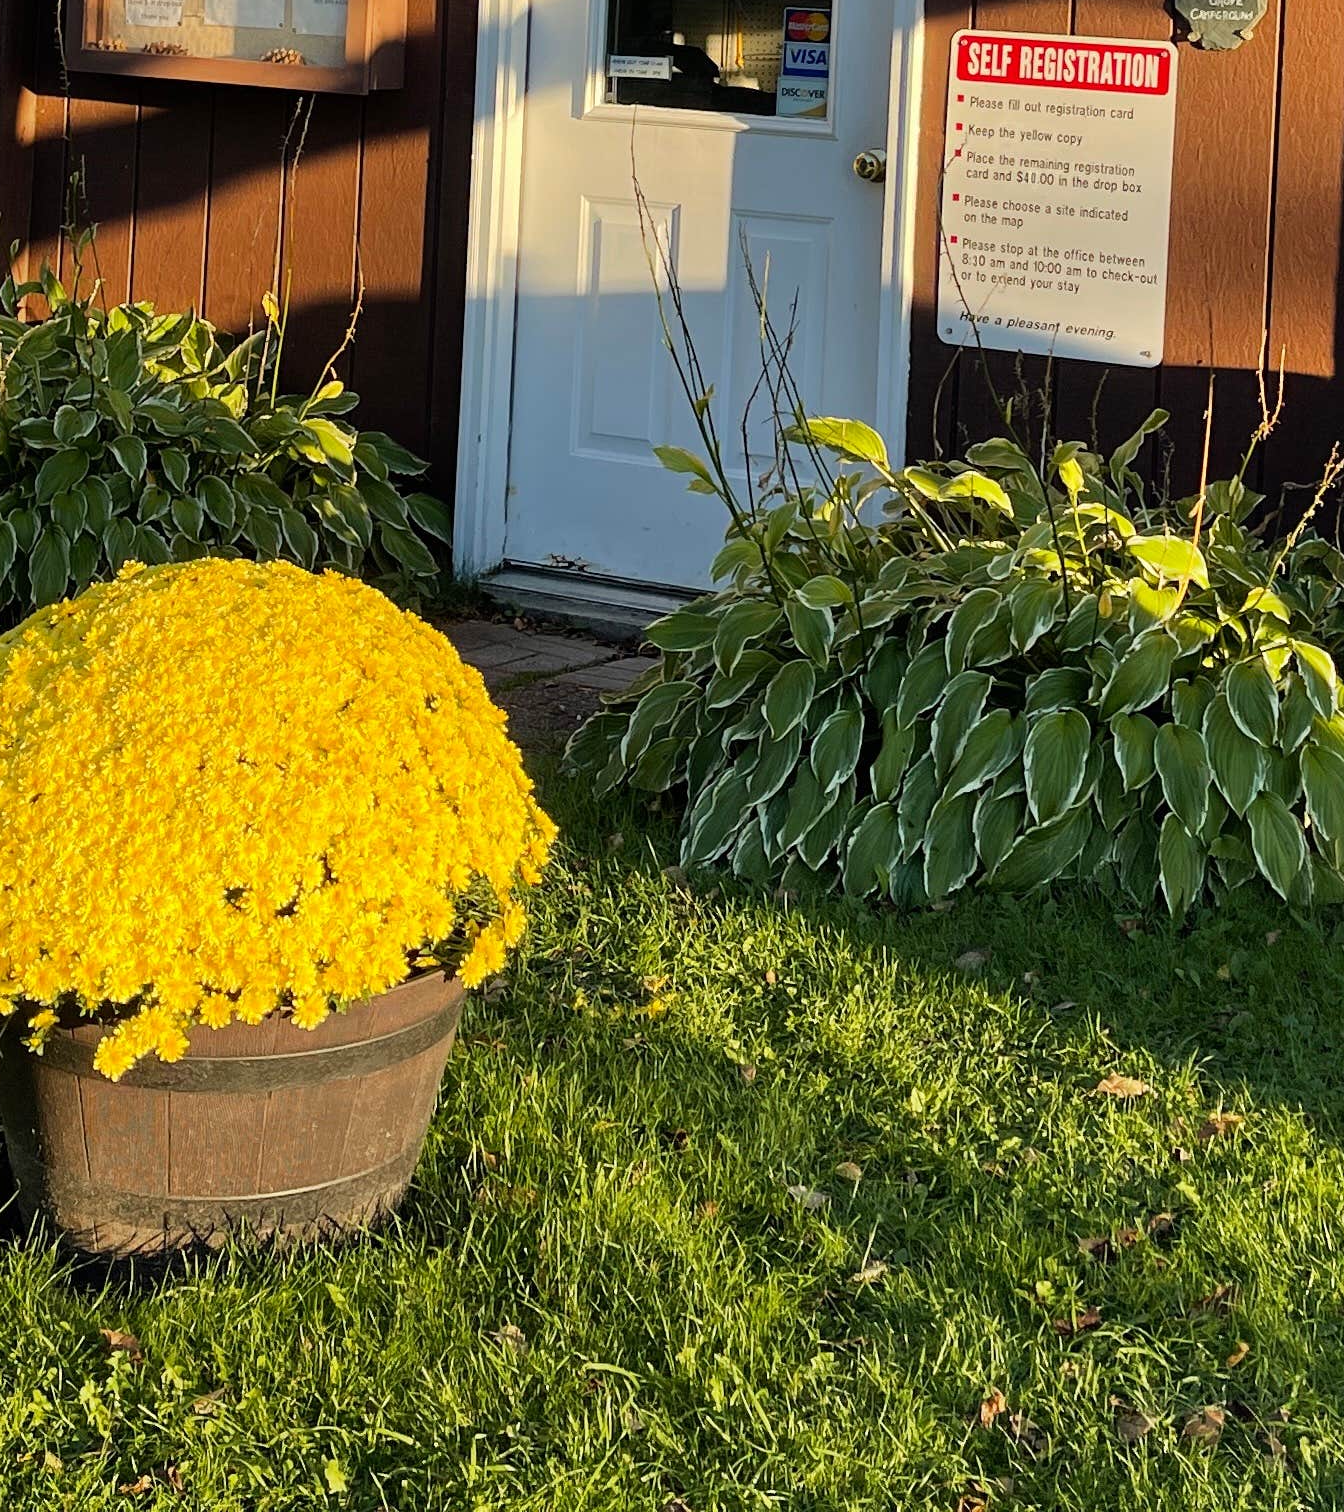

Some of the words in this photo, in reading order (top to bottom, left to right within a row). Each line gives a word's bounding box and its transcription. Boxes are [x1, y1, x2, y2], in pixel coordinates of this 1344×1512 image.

[1190, 8, 1254, 20] CAMPGROUND
[790, 49, 827, 65] VISA
[967, 42, 1013, 77] SELF
[1019, 46, 1160, 88] REGISTRATION
[781, 88, 825, 99] DISCOVER
[970, 96, 1004, 109] Please
[1008, 99, 1020, 111] fill
[1024, 102, 1041, 113] out
[1046, 103, 1105, 117] registration
[1110, 108, 1134, 120] card
[968, 124, 995, 139] Keep
[999, 127, 1015, 139] the
[1020, 130, 1053, 141] yellow
[1057, 133, 1083, 146] copy
[967, 151, 994, 165] Place
[999, 154, 1015, 166] the
[1020, 157, 1070, 173] remaining
[1075, 161, 1135, 176] registration
[966, 168, 989, 180] card
[993, 171, 1012, 182] and
[1059, 175, 1067, 186] in
[1072, 176, 1089, 188] the
[1093, 179, 1118, 193] drop
[1122, 180, 1142, 193] box
[964, 195, 998, 209] Please
[1002, 199, 1041, 214] choose
[1045, 205, 1052, 214] a
[1056, 204, 1075, 217] site
[1079, 206, 1129, 222] indicated
[964, 213, 976, 222] on
[981, 213, 997, 225] the
[1001, 216, 1024, 229] map
[962, 238, 996, 252] Please
[1000, 242, 1024, 256] stop
[1027, 245, 1038, 256] at
[1043, 246, 1059, 258] the
[1064, 249, 1095, 262] office
[1099, 252, 1145, 267] between
[961, 253, 986, 267] 8:30
[990, 258, 1006, 269] am
[1010, 260, 1029, 271] and
[1034, 260, 1062, 275] 10:00
[1066, 266, 1082, 276] am
[1086, 267, 1097, 278] to
[1102, 268, 1159, 285] check-out
[961, 271, 972, 280] or
[976, 270, 986, 282] to
[991, 274, 1026, 286] extend
[1030, 278, 1053, 290] your
[1057, 279, 1080, 294] stay
[959, 311, 990, 324] Have
[994, 317, 1002, 325] a
[1007, 316, 1060, 332] pleasant
